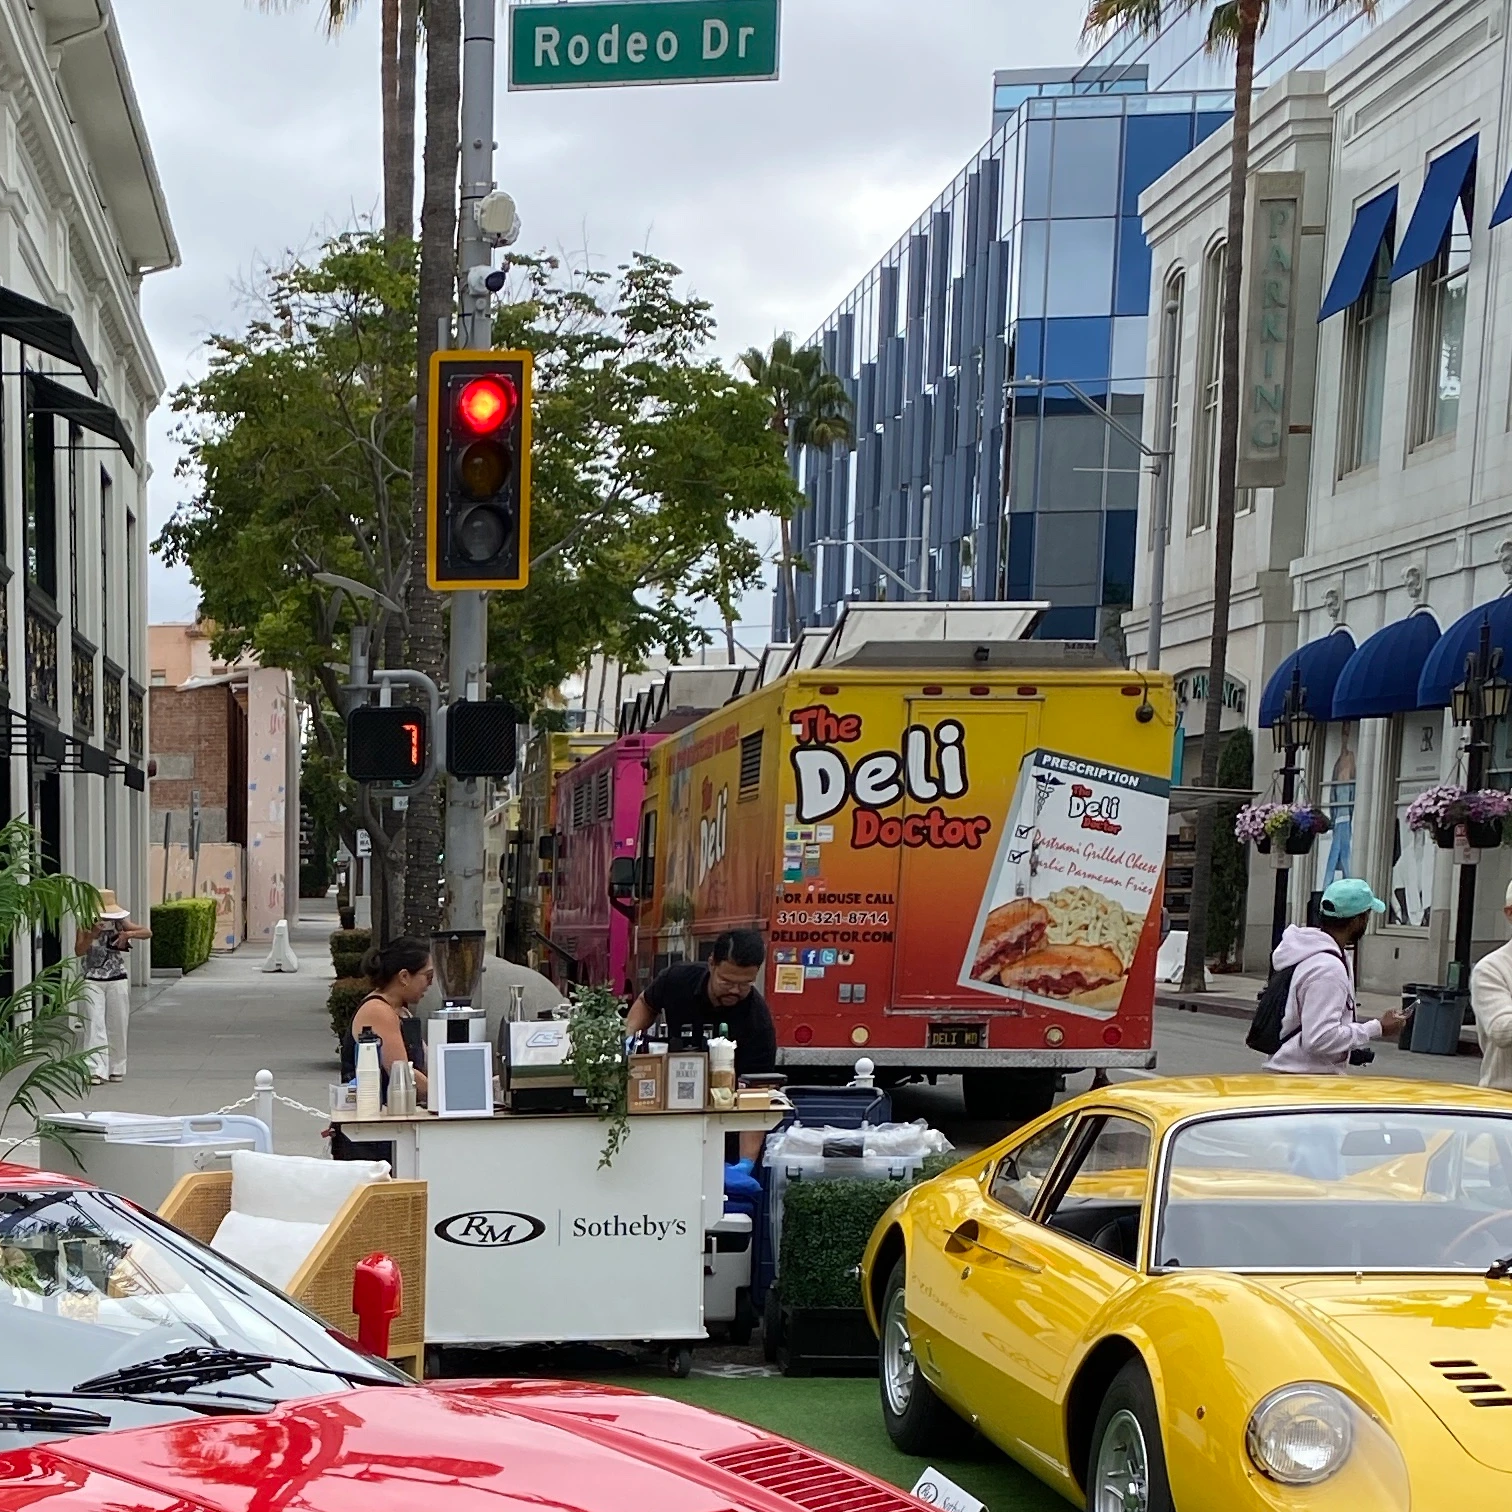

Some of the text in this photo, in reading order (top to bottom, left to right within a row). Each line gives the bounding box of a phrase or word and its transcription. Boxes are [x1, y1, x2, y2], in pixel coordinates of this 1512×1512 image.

[534, 18, 755, 67] Rodeo Dr
[1251, 208, 1292, 450] PARKING
[791, 706, 861, 743] The
[402, 724, 418, 766] 7
[793, 721, 966, 822] Deli
[1041, 754, 1140, 787] PRESCRIPTION
[1068, 796, 1120, 820] Deli
[1071, 784, 1092, 798] The
[698, 782, 728, 886] Deli
[853, 808, 989, 848] Doctor
[1081, 815, 1122, 835] Doctor
[1032, 829, 1080, 855] Pastrami
[1082, 842, 1123, 866] Grilled
[1124, 851, 1158, 874] Cheese
[1066, 861, 1123, 887] Parmesan
[1124, 876, 1153, 896] Fries
[804, 893, 814, 905] A
[817, 893, 862, 905] HOUSE
[865, 893, 895, 905] CALL
[777, 911, 890, 926] 310-321-8714
[770, 930, 894, 944] DELIDOCTOR.COM
[931, 1032, 958, 1046] DELI
[572, 1214, 687, 1241] Sotheby's
